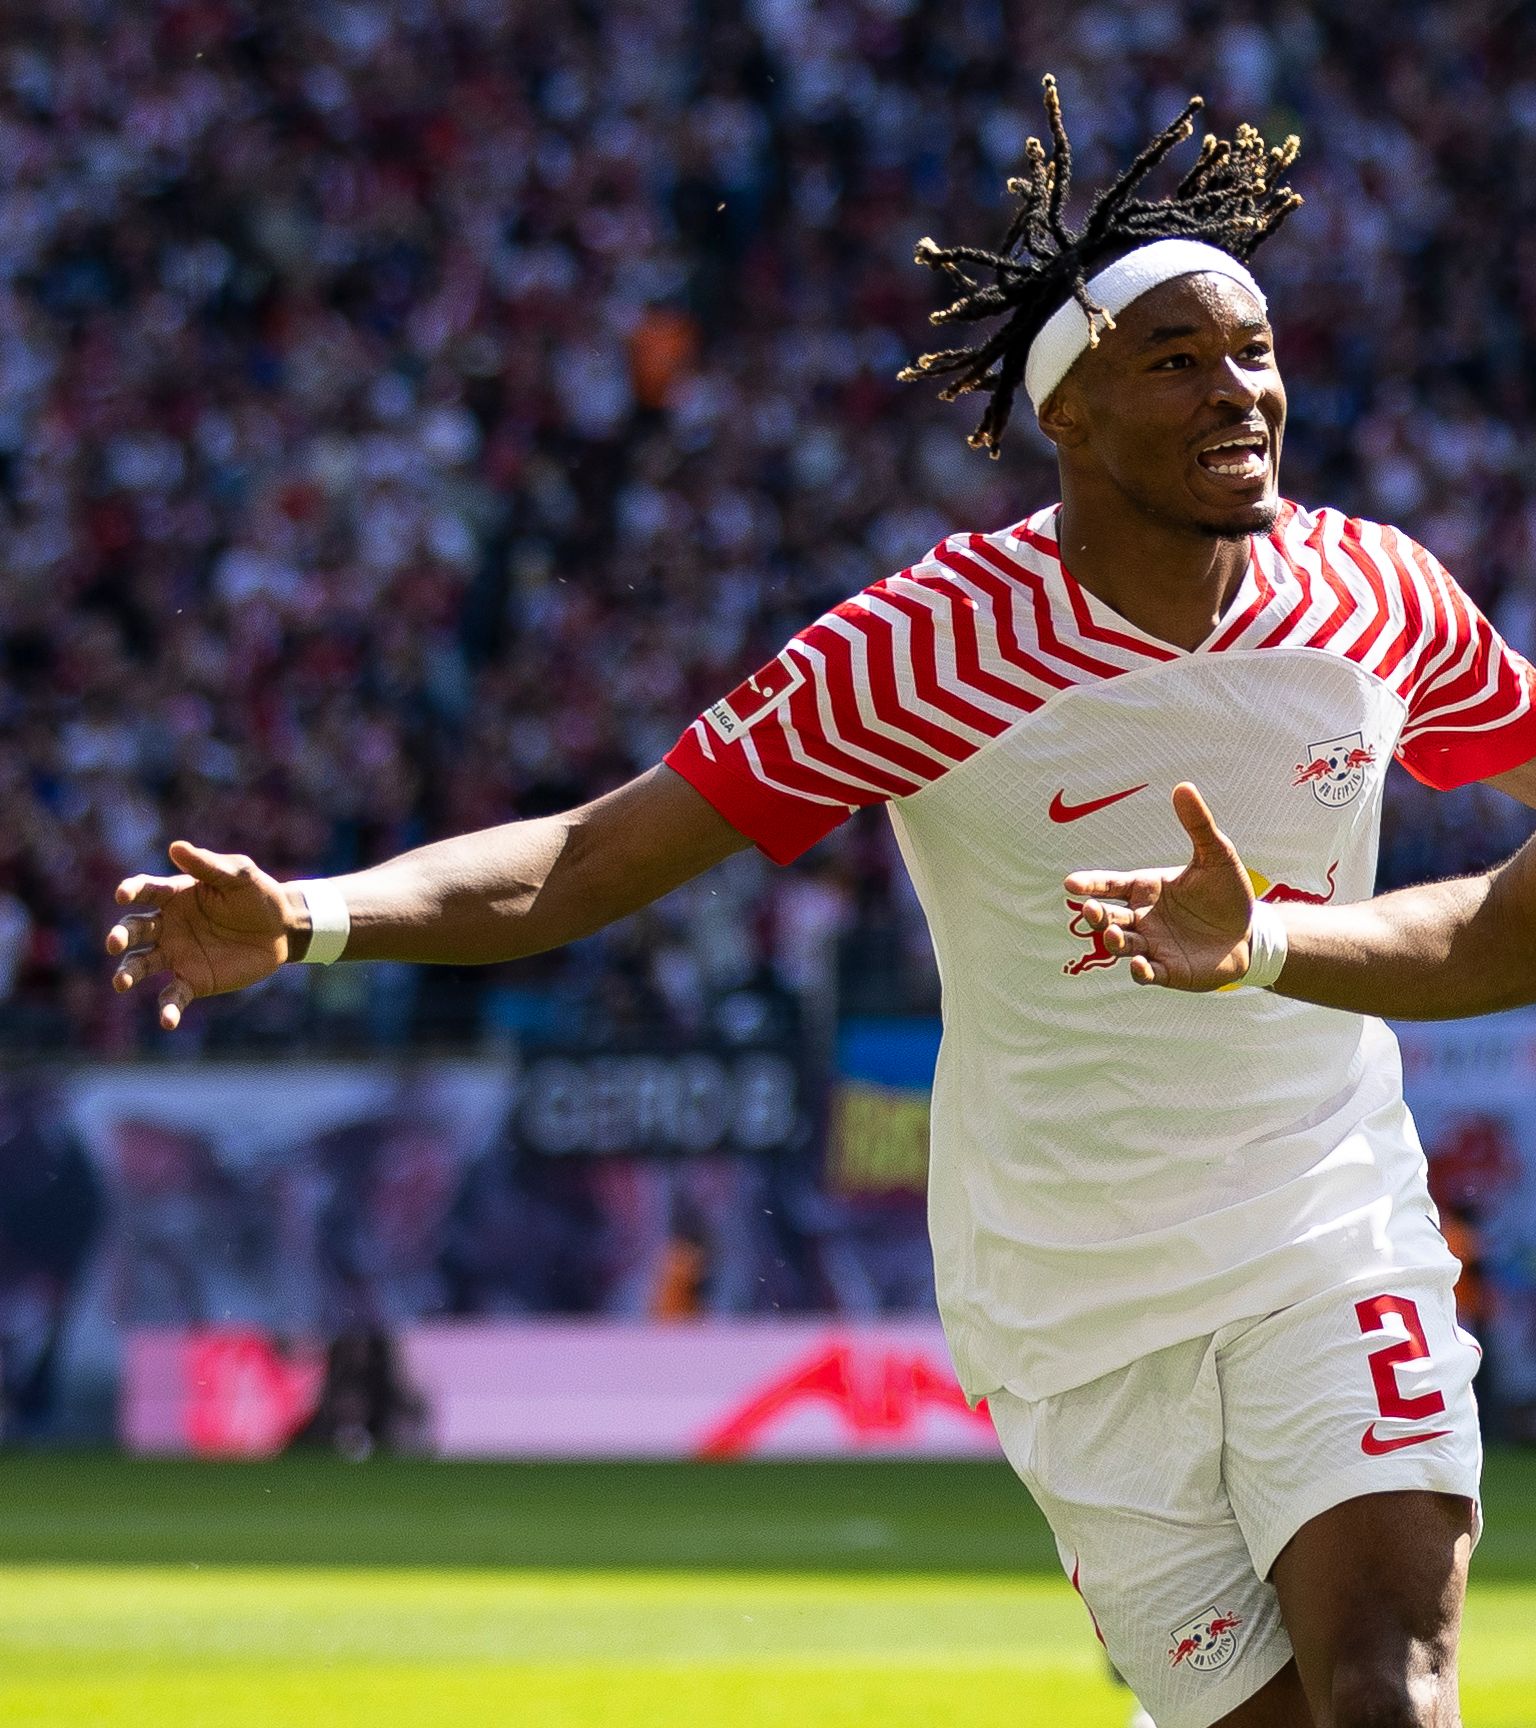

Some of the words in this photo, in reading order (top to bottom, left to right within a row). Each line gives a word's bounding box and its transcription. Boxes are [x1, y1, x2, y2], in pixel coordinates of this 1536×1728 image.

[711, 704, 735, 733] LIGA
[1332, 773, 1361, 801] LEIPZIG
[1354, 1293, 1446, 1420] 2
[1206, 1637, 1231, 1665] LEIPZIG
